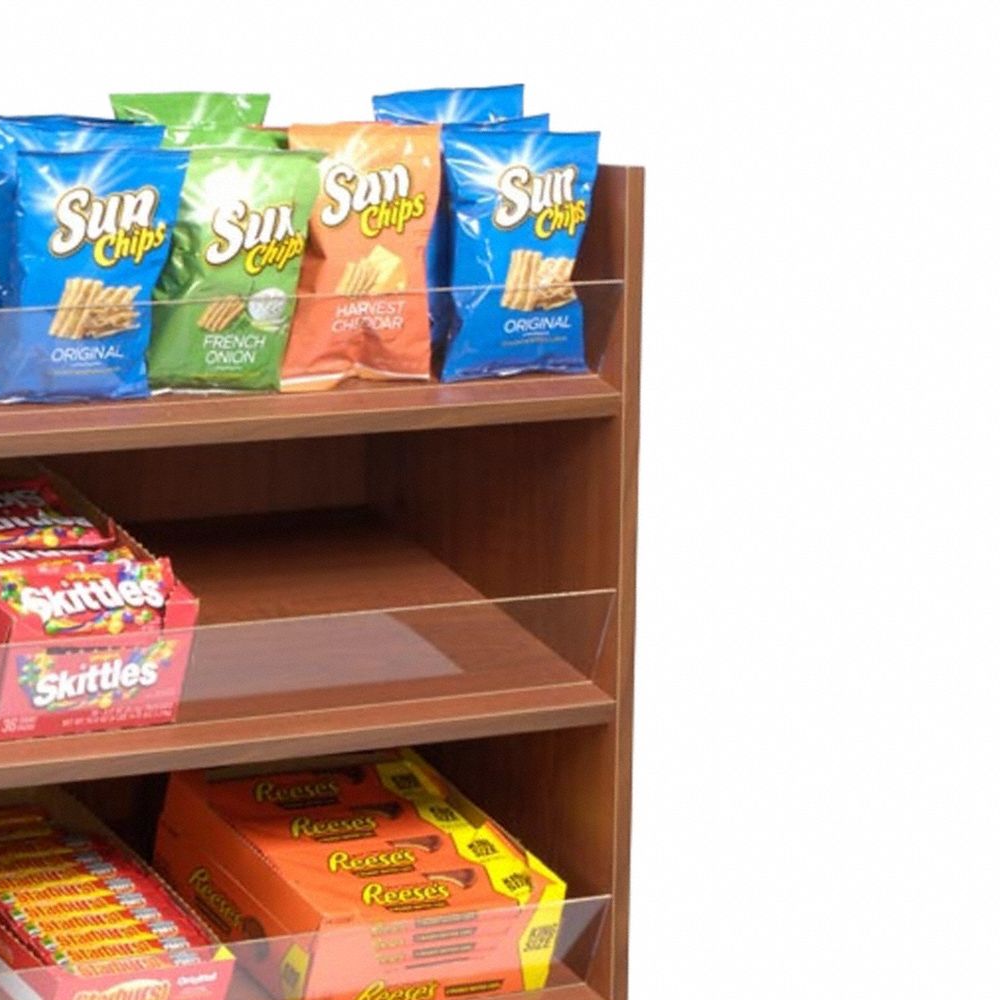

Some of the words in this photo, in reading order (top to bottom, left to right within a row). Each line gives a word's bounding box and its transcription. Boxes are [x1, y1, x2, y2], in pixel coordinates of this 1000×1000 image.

[320, 163, 410, 228] Sun
[493, 165, 579, 228] Sun
[50, 186, 157, 257] Sun
[361, 194, 426, 238] Chips
[535, 201, 586, 240] Chips
[93, 222, 166, 268] Chips
[335, 300, 407, 318] HARVEST
[503, 315, 572, 334] ORIGINAL
[50, 345, 124, 363] ORIGINAL
[203, 333, 266, 350] FRENCH
[205, 350, 257, 365] ONION
[20, 577, 165, 622] Skittles
[13, 658, 159, 707] Skittles
[290, 816, 378, 838] Reese's
[328, 851, 416, 873] Reese's
[362, 882, 450, 906] Reese's
